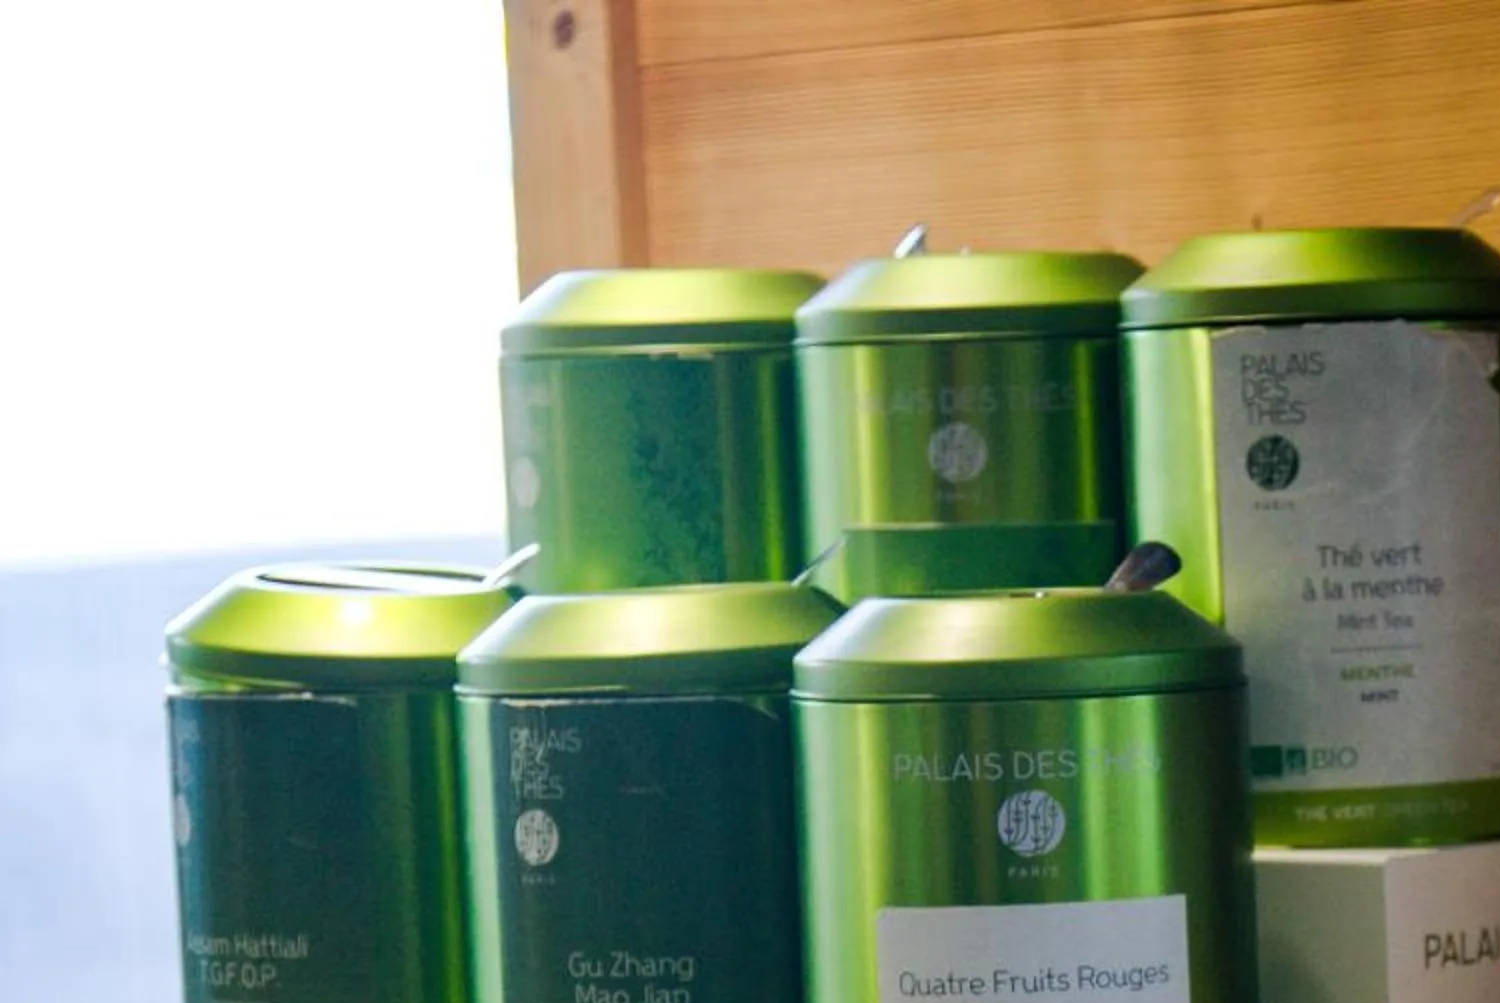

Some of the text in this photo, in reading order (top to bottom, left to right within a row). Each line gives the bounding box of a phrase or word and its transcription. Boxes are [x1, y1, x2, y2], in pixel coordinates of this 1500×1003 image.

[1241, 351, 1327, 376] PALAIS
[1242, 377, 1290, 402] DES
[1317, 541, 1423, 569] Thé vert
[1322, 575, 1344, 600] la
[1351, 573, 1445, 600] menthe
[1340, 663, 1416, 682] MENTHE
[893, 752, 1004, 781] PALAIS
[1012, 750, 1078, 780] DES
[1311, 747, 1359, 770] BIO
[1007, 865, 1060, 879] PARIS
[567, 950, 696, 982] Gu Zhang
[899, 963, 1171, 998] Quatre Fruits Rouges
